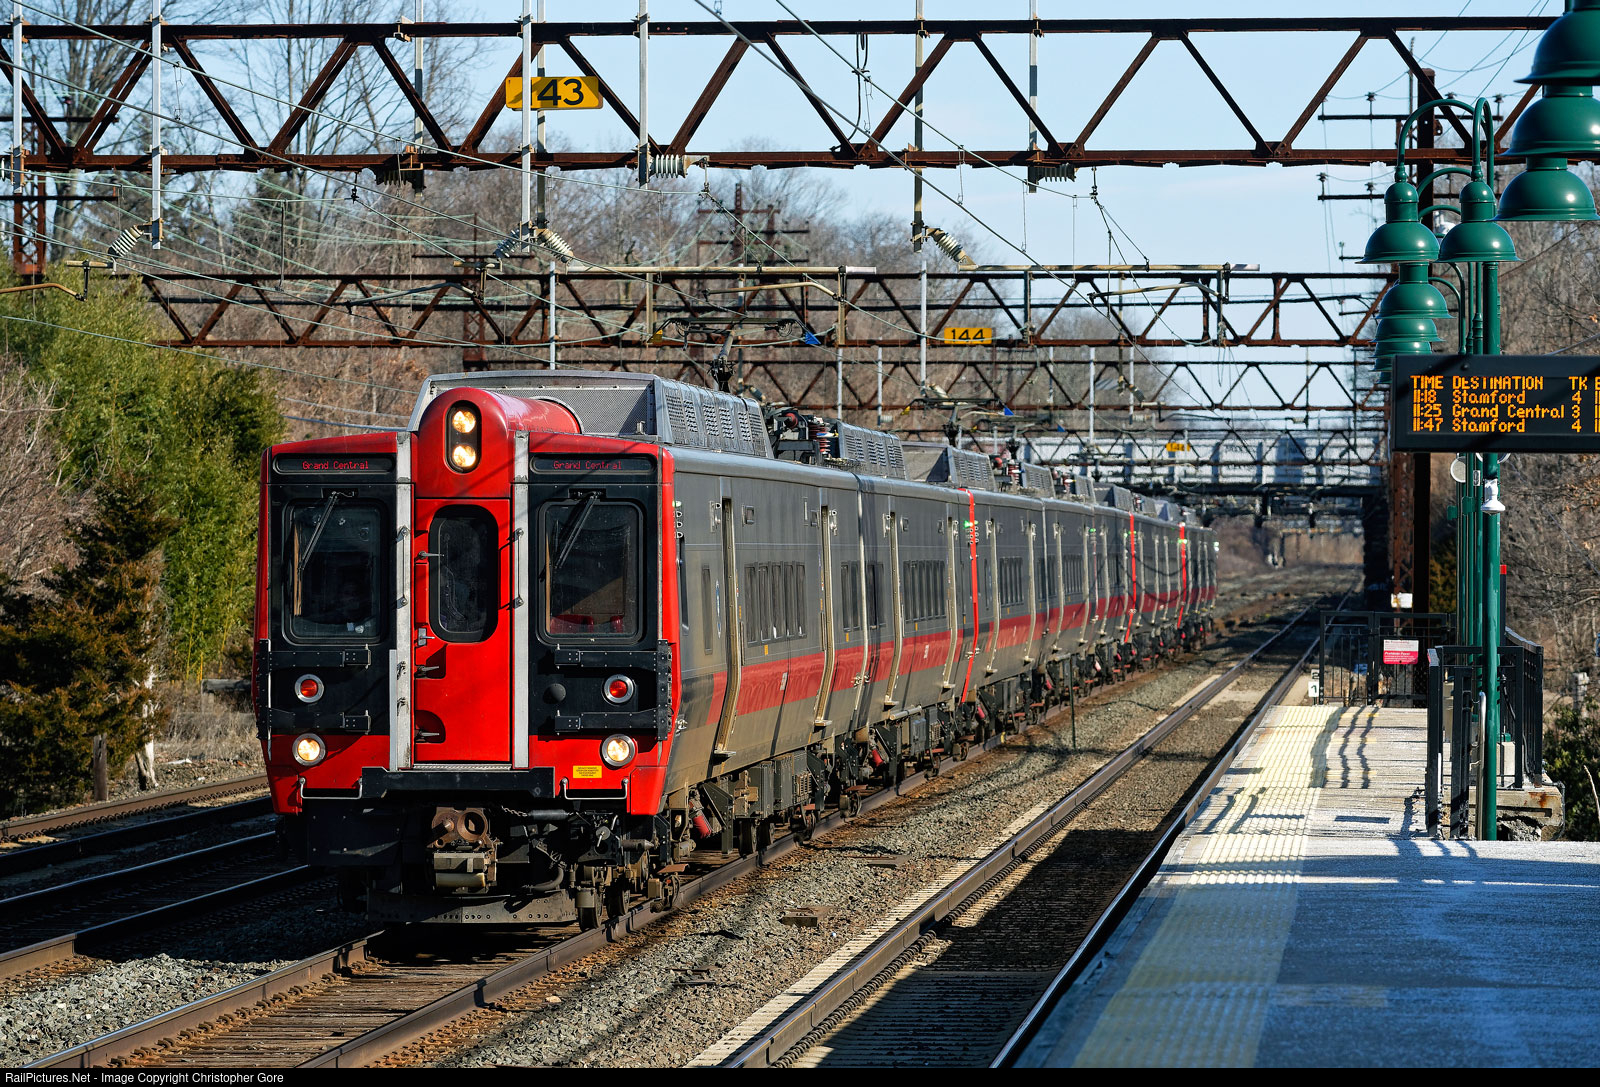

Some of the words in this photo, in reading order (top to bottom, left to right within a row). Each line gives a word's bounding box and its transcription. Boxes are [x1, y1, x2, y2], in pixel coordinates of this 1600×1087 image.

[530, 78, 584, 106] 43
[951, 329, 985, 342] 144
[1410, 375, 1444, 390] TIME
[1453, 375, 1543, 390] DESTINATION
[1568, 376, 1588, 391] TK
[1413, 390, 1437, 404] 11:18
[1452, 390, 1526, 404] Stamford
[1571, 390, 1582, 404] 4
[1412, 404, 1442, 418] 11:25
[1452, 404, 1499, 418] Grand
[1507, 404, 1565, 418] Central
[1571, 404, 1581, 418] 3
[1412, 418, 1444, 432] 11:47
[1452, 418, 1526, 432] Stamford
[1571, 418, 1582, 432] 4
[302, 461, 329, 470] Grand
[333, 461, 369, 470] Central
[553, 461, 581, 470] Grand
[585, 461, 622, 470] Central
